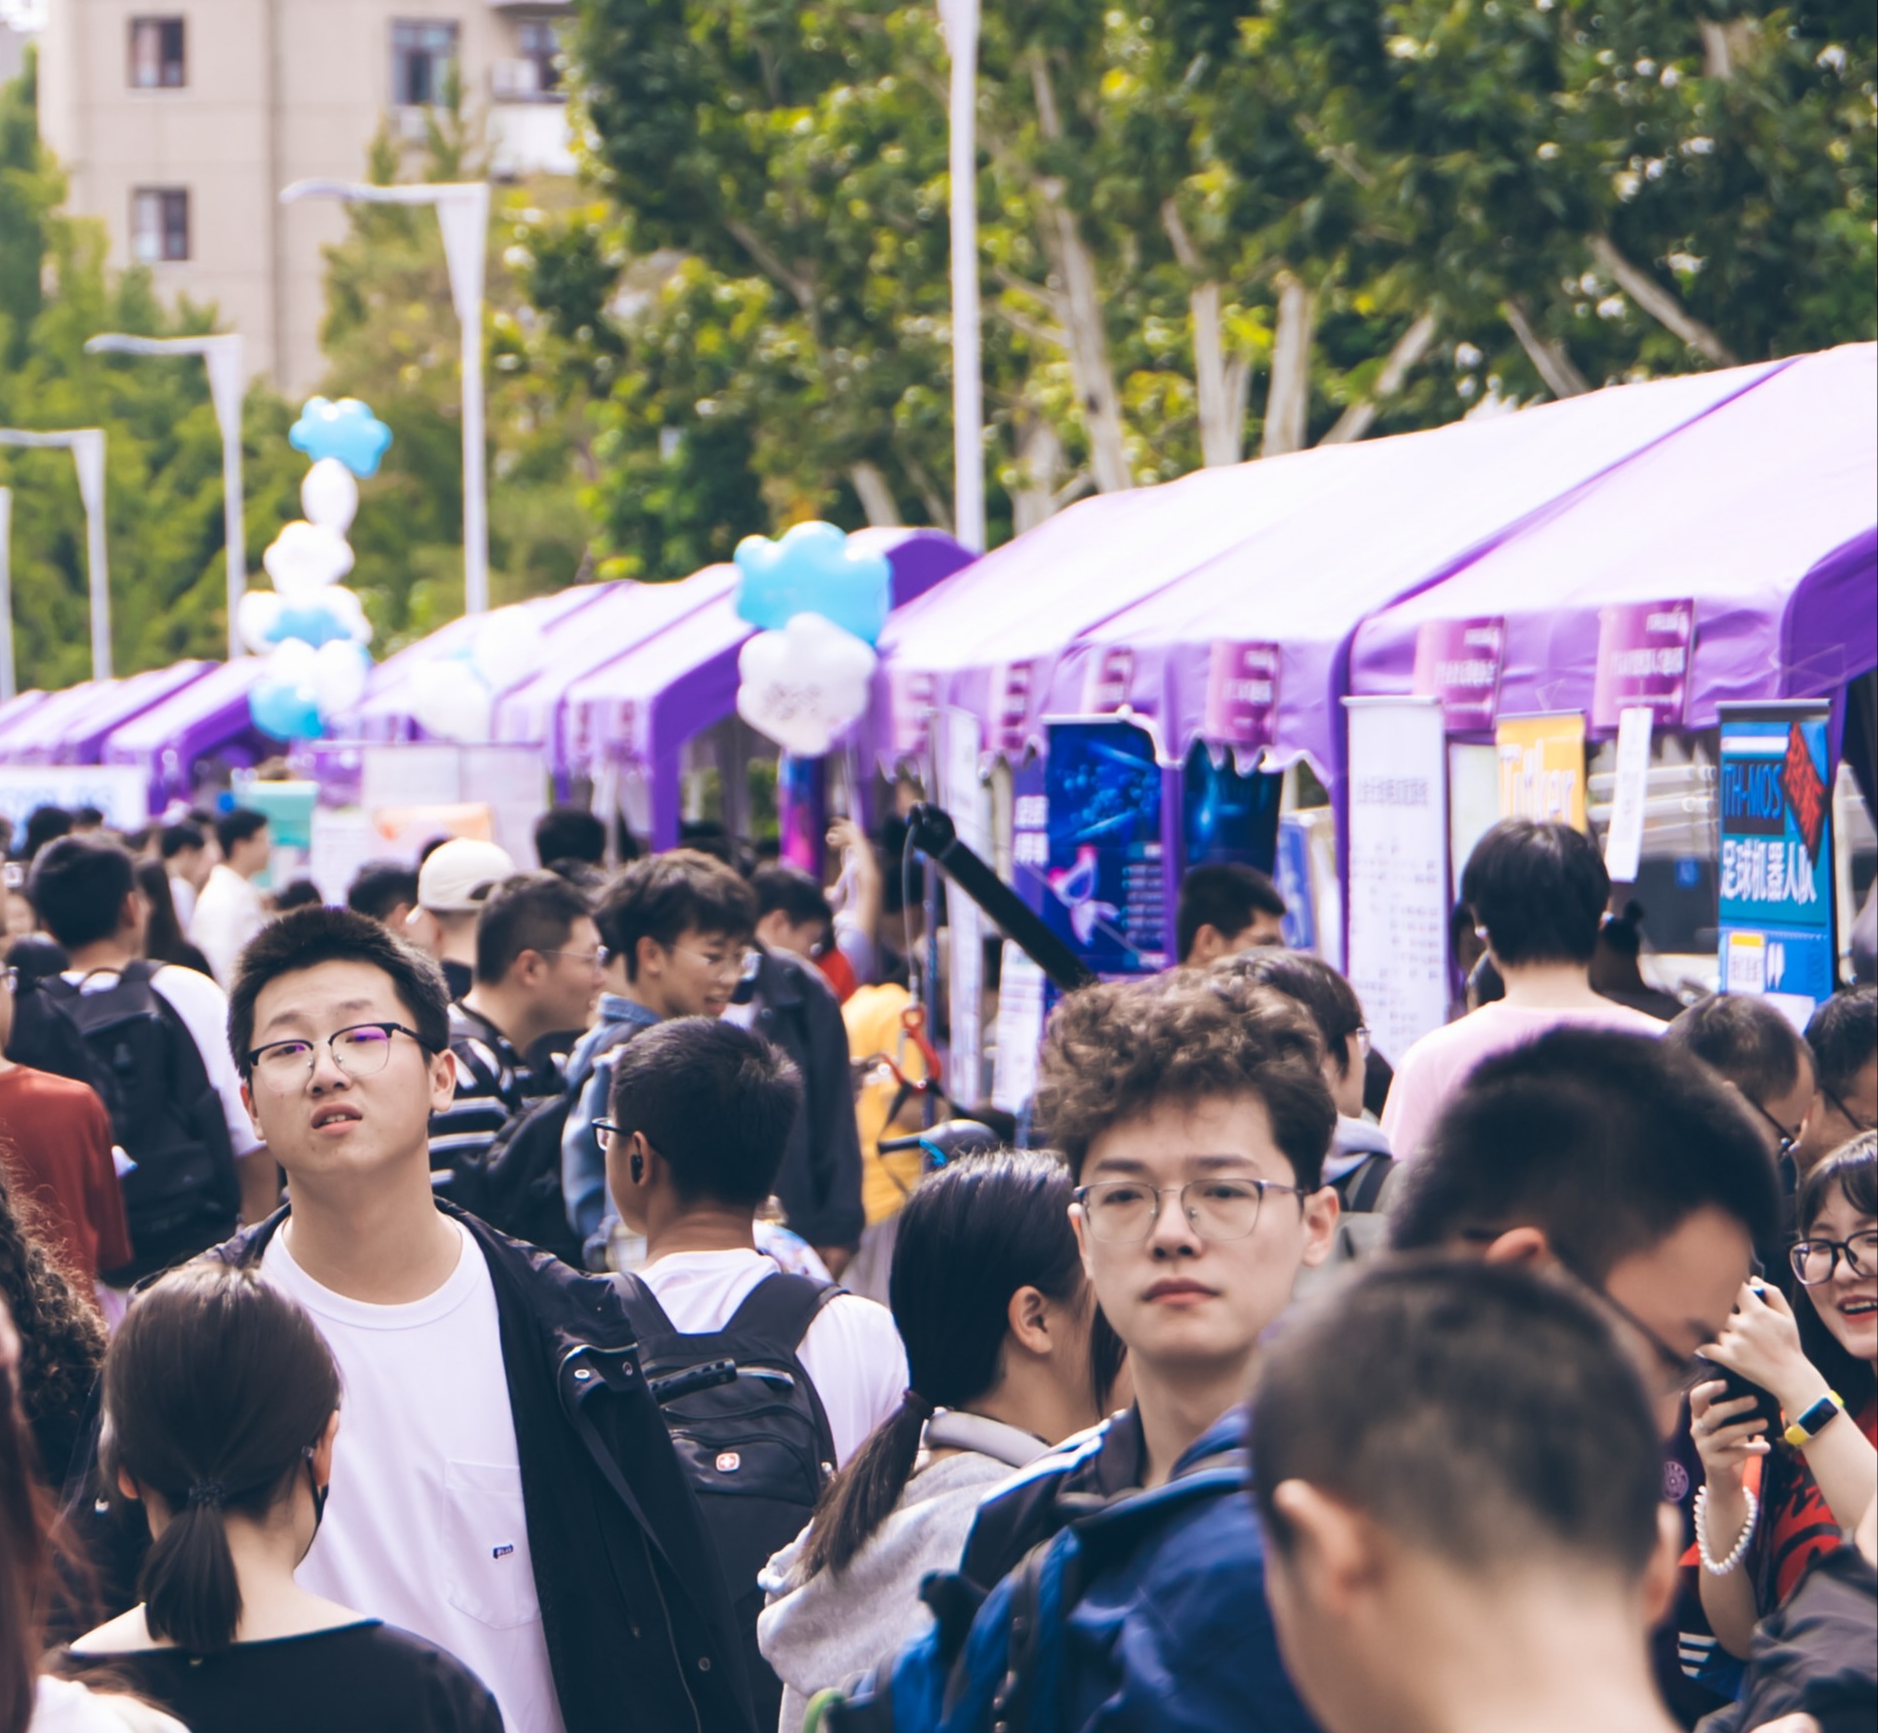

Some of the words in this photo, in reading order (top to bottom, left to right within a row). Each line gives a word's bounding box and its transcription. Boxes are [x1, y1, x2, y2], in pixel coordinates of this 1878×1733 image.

[1721, 839, 1817, 905] 足球机器人队
